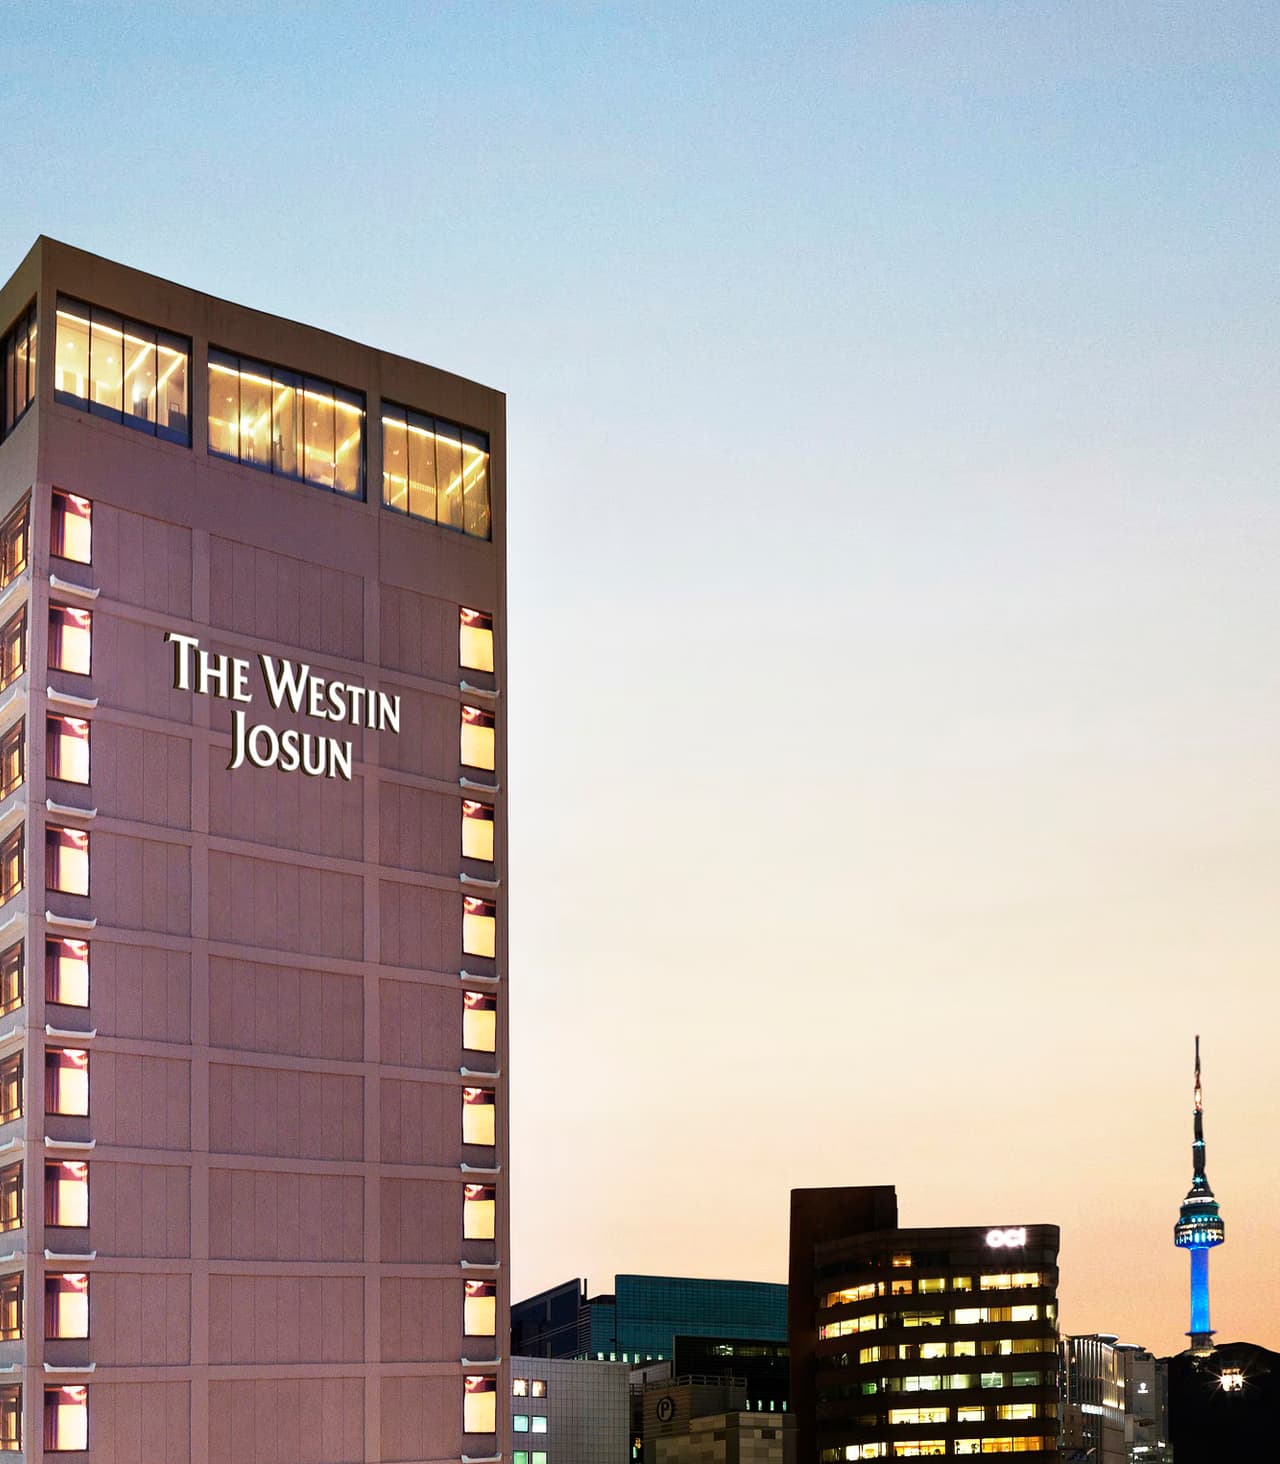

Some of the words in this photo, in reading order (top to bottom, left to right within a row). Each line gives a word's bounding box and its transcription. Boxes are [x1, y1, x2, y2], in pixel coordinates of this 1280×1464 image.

[164, 631, 252, 703] THE
[258, 653, 401, 734] WESTIN
[227, 709, 352, 780] JOSUN
